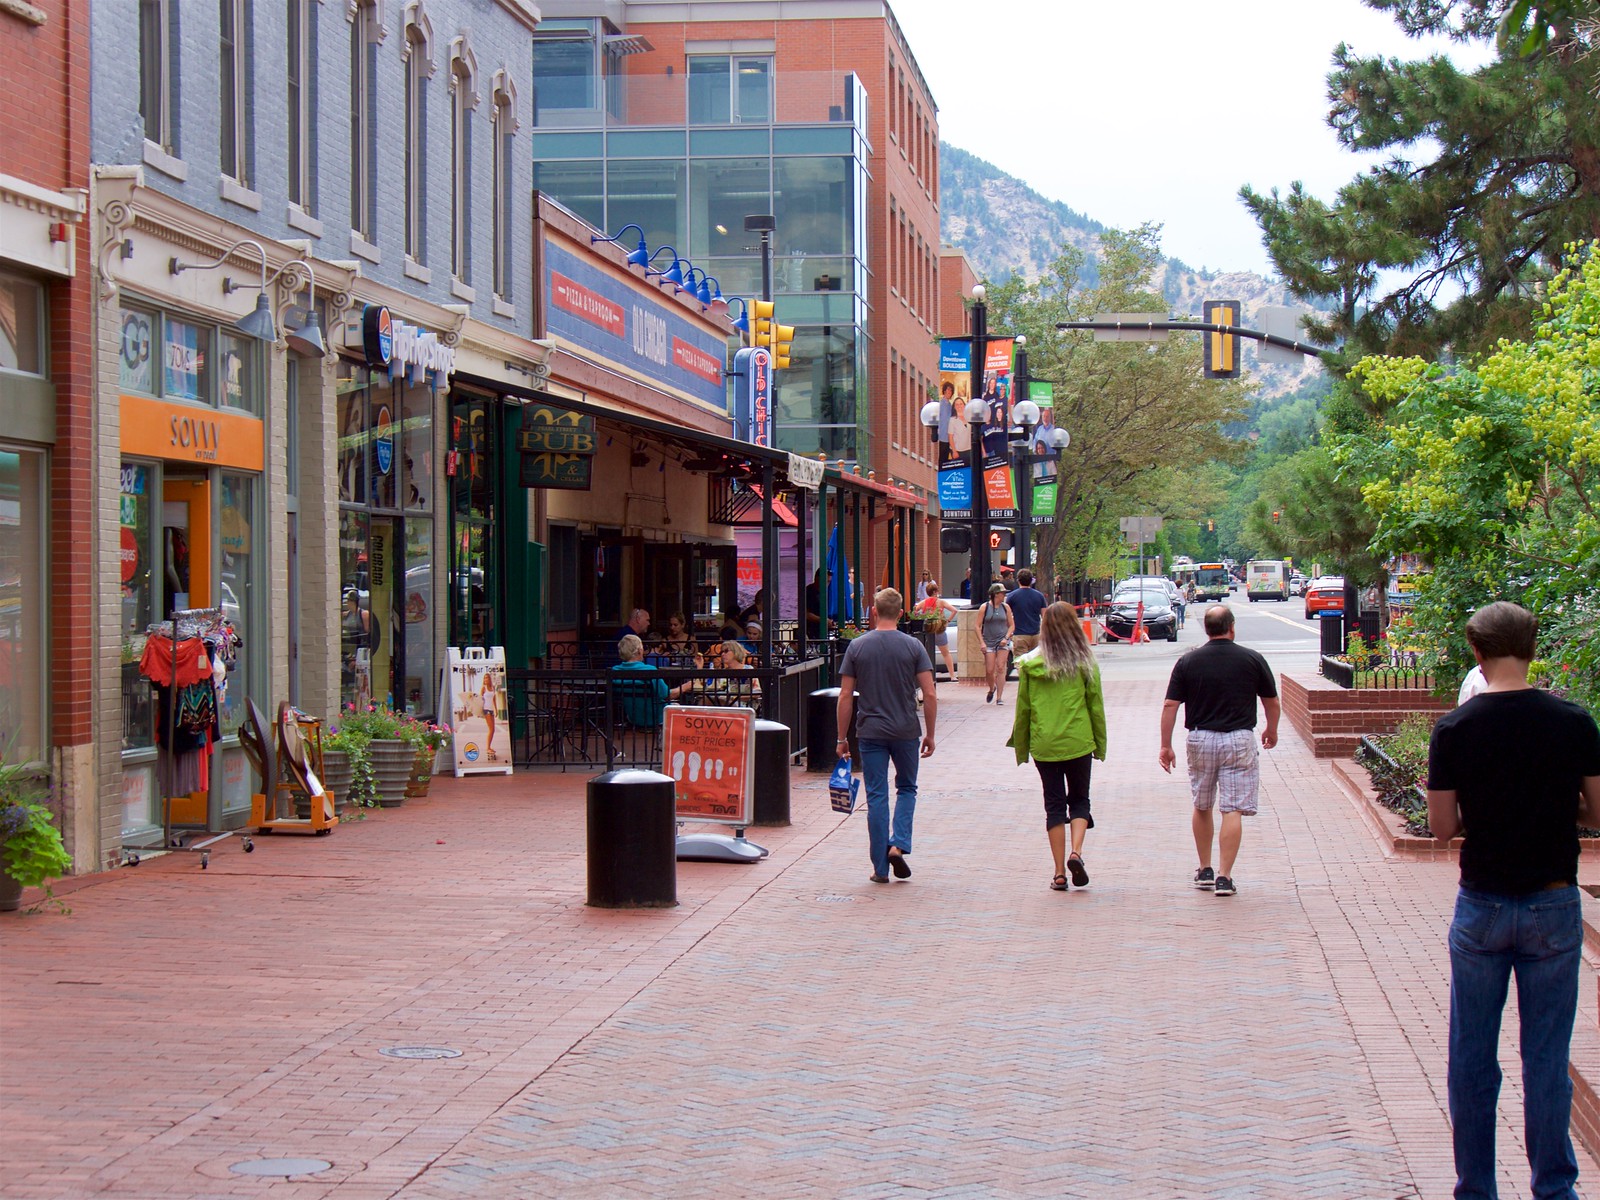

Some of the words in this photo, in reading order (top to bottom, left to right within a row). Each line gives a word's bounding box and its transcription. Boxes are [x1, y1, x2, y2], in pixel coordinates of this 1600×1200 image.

[566, 286, 582, 308] PIZZA
[589, 297, 613, 324] TAPROOM
[120, 313, 150, 371] GG
[633, 304, 644, 356] OLD
[644, 310, 667, 367] CHICAGO
[171, 345, 191, 371] TOMS
[754, 353, 768, 391] OLD
[521, 431, 593, 451] PUB
[120, 466, 137, 493] eef
[567, 464, 578, 475] &
[372, 535, 384, 586] COLORADO
[680, 736, 702, 745] BEST
[704, 737, 736, 747] PRICES
